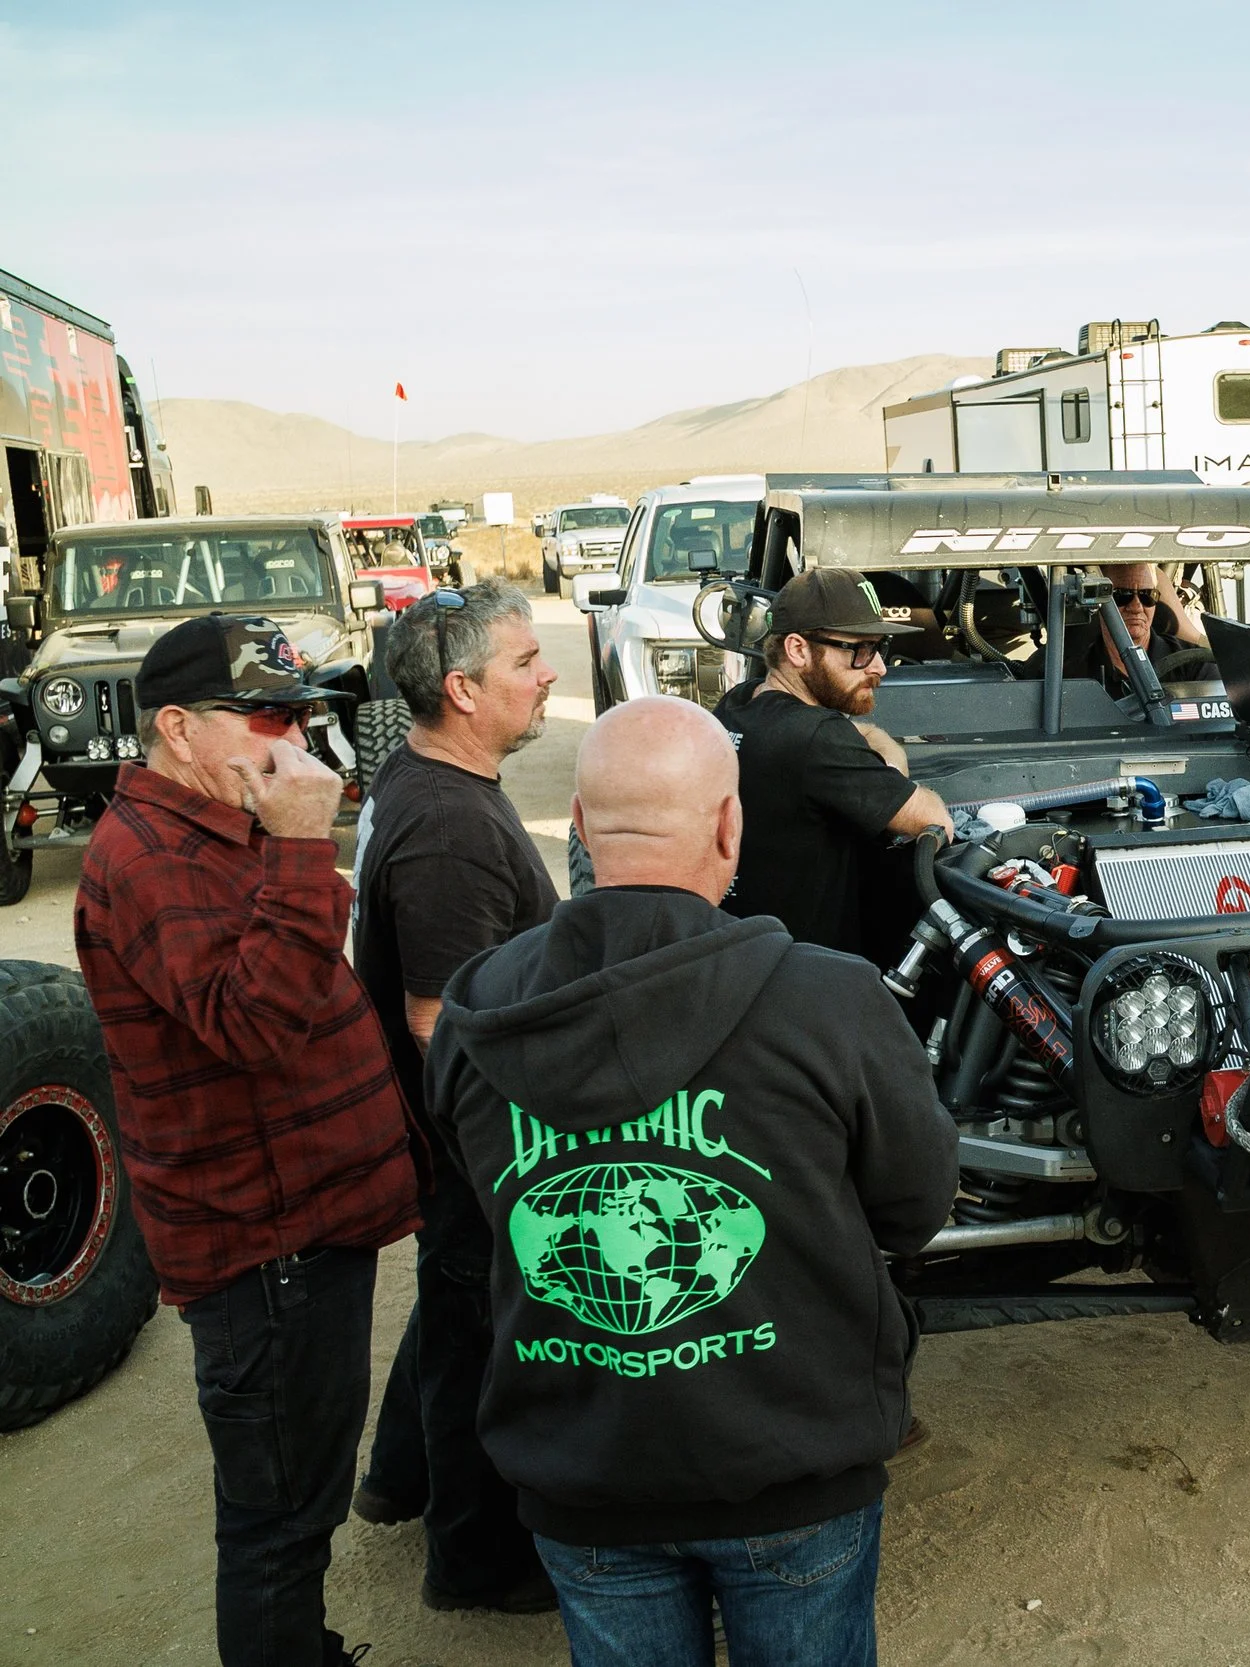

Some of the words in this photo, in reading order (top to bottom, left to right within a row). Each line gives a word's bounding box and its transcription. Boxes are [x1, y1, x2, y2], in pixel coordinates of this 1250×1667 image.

[1200, 701, 1234, 719] CAS
[979, 955, 1003, 977] VALVE
[515, 1322, 777, 1378] MOTORSPORTS
